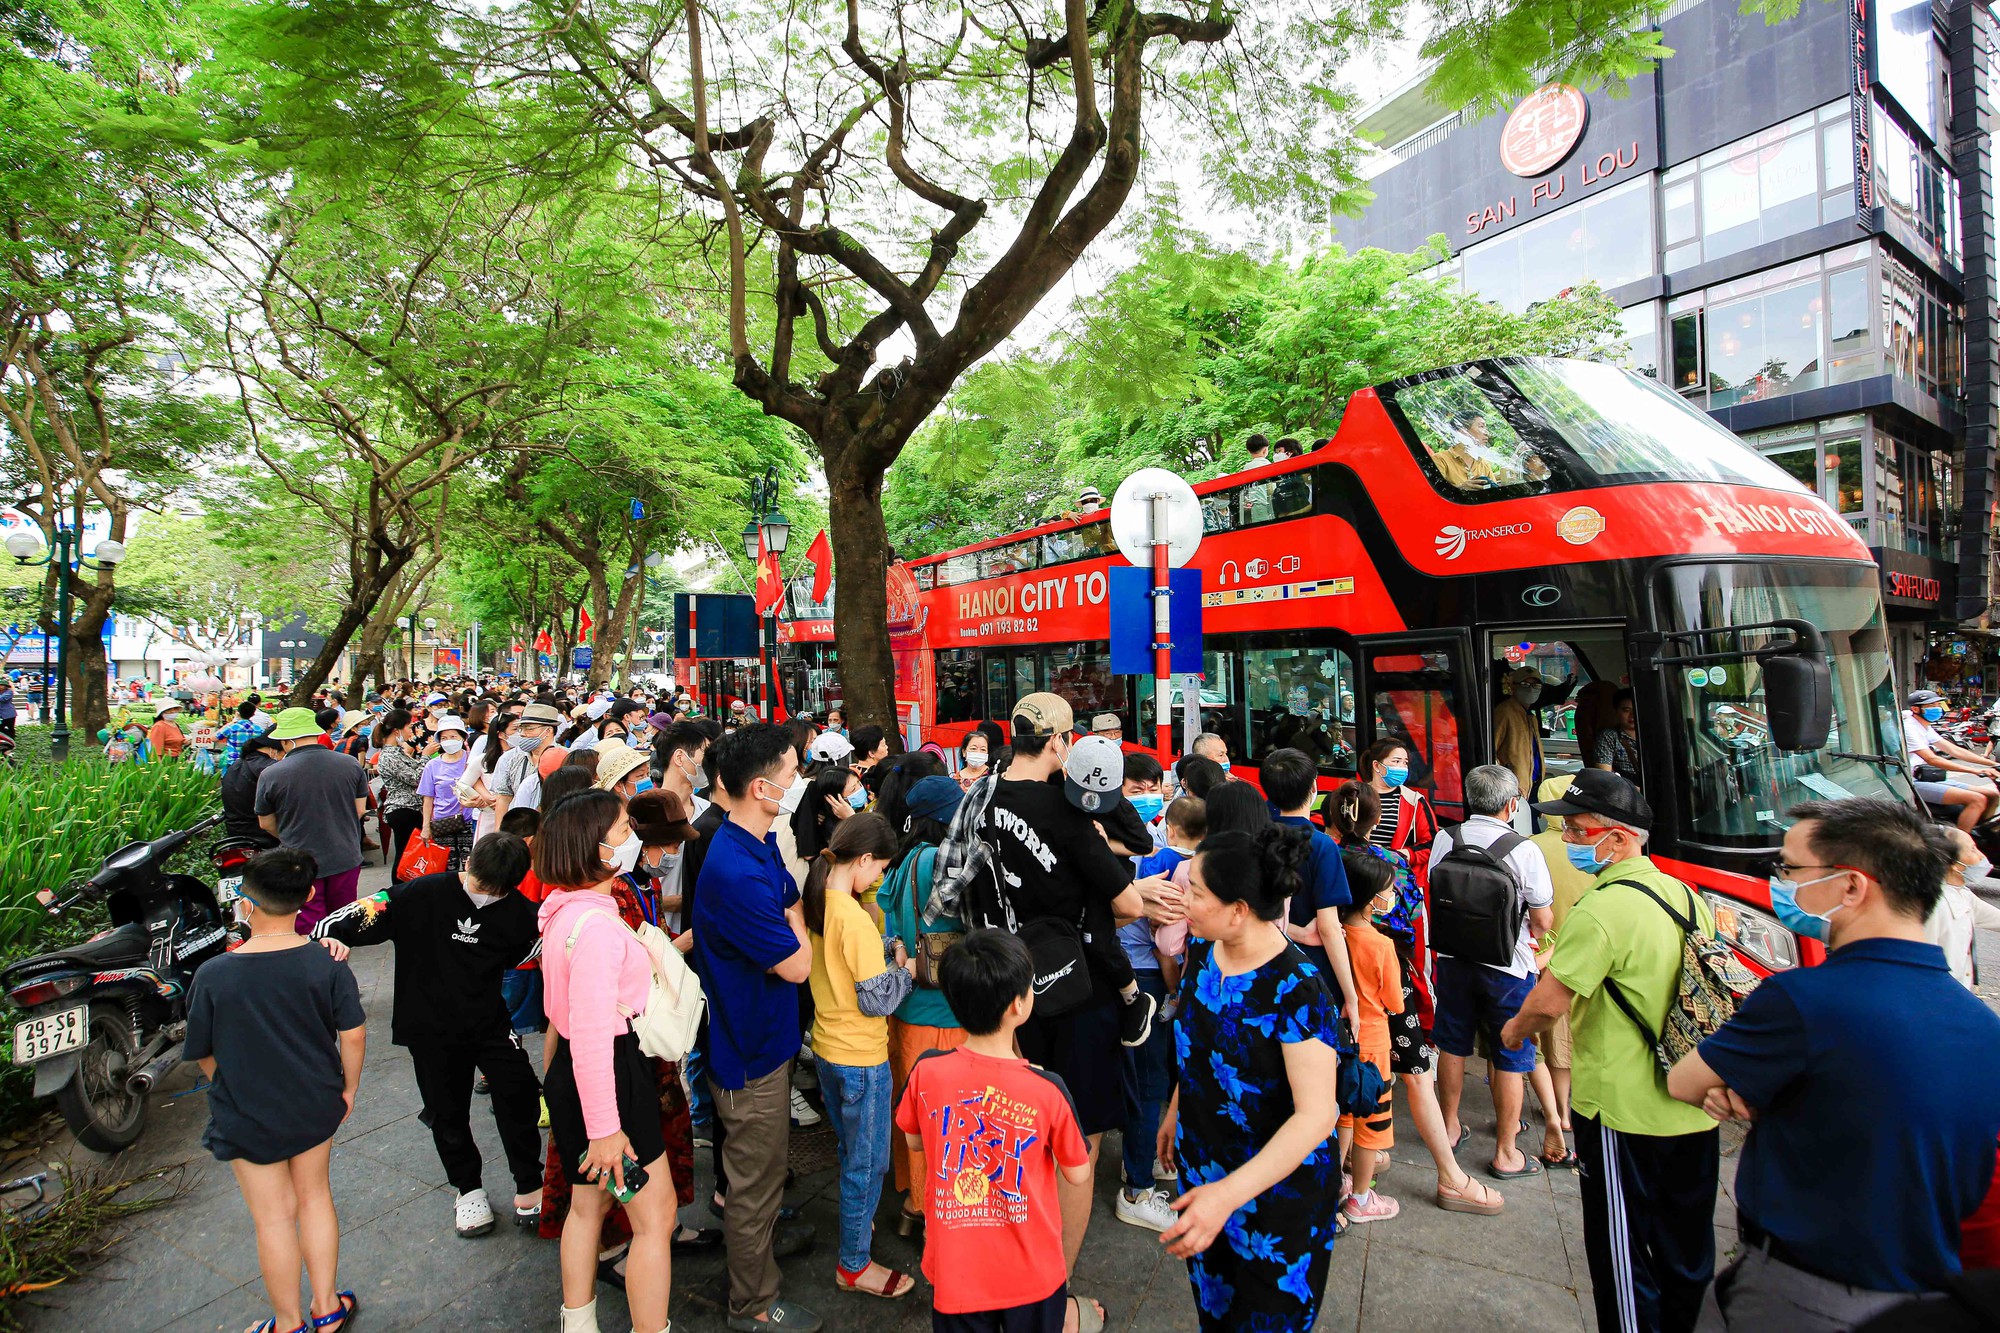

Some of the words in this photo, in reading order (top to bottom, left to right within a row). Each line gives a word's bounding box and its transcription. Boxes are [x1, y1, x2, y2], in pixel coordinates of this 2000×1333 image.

[1466, 196, 1516, 234] SAN
[1531, 174, 1565, 207] FU
[1581, 141, 1639, 186] LOU
[1694, 503, 1797, 536] HANOI
[1788, 506, 1838, 537] CITY
[1465, 522, 1532, 541] TRANSERCO
[959, 585, 1015, 620] HANOI
[1020, 577, 1068, 613] CITY
[1074, 570, 1109, 606] TO
[979, 622, 994, 636] 091
[996, 621, 1012, 635] 193
[1013, 619, 1025, 633] 82
[1026, 617, 1039, 632] 82
[451, 933, 479, 944] adidas
[28, 959, 67, 971] HONDA
[25, 1011, 77, 1041] 29-S6
[26, 1029, 77, 1058] 3974
[945, 1209, 970, 1220] GOOD
[970, 1208, 989, 1218] ARE
[990, 1208, 1007, 1220] YOU
[1007, 1213, 1028, 1224] WOH
[1007, 1204, 1028, 1214] WOH
